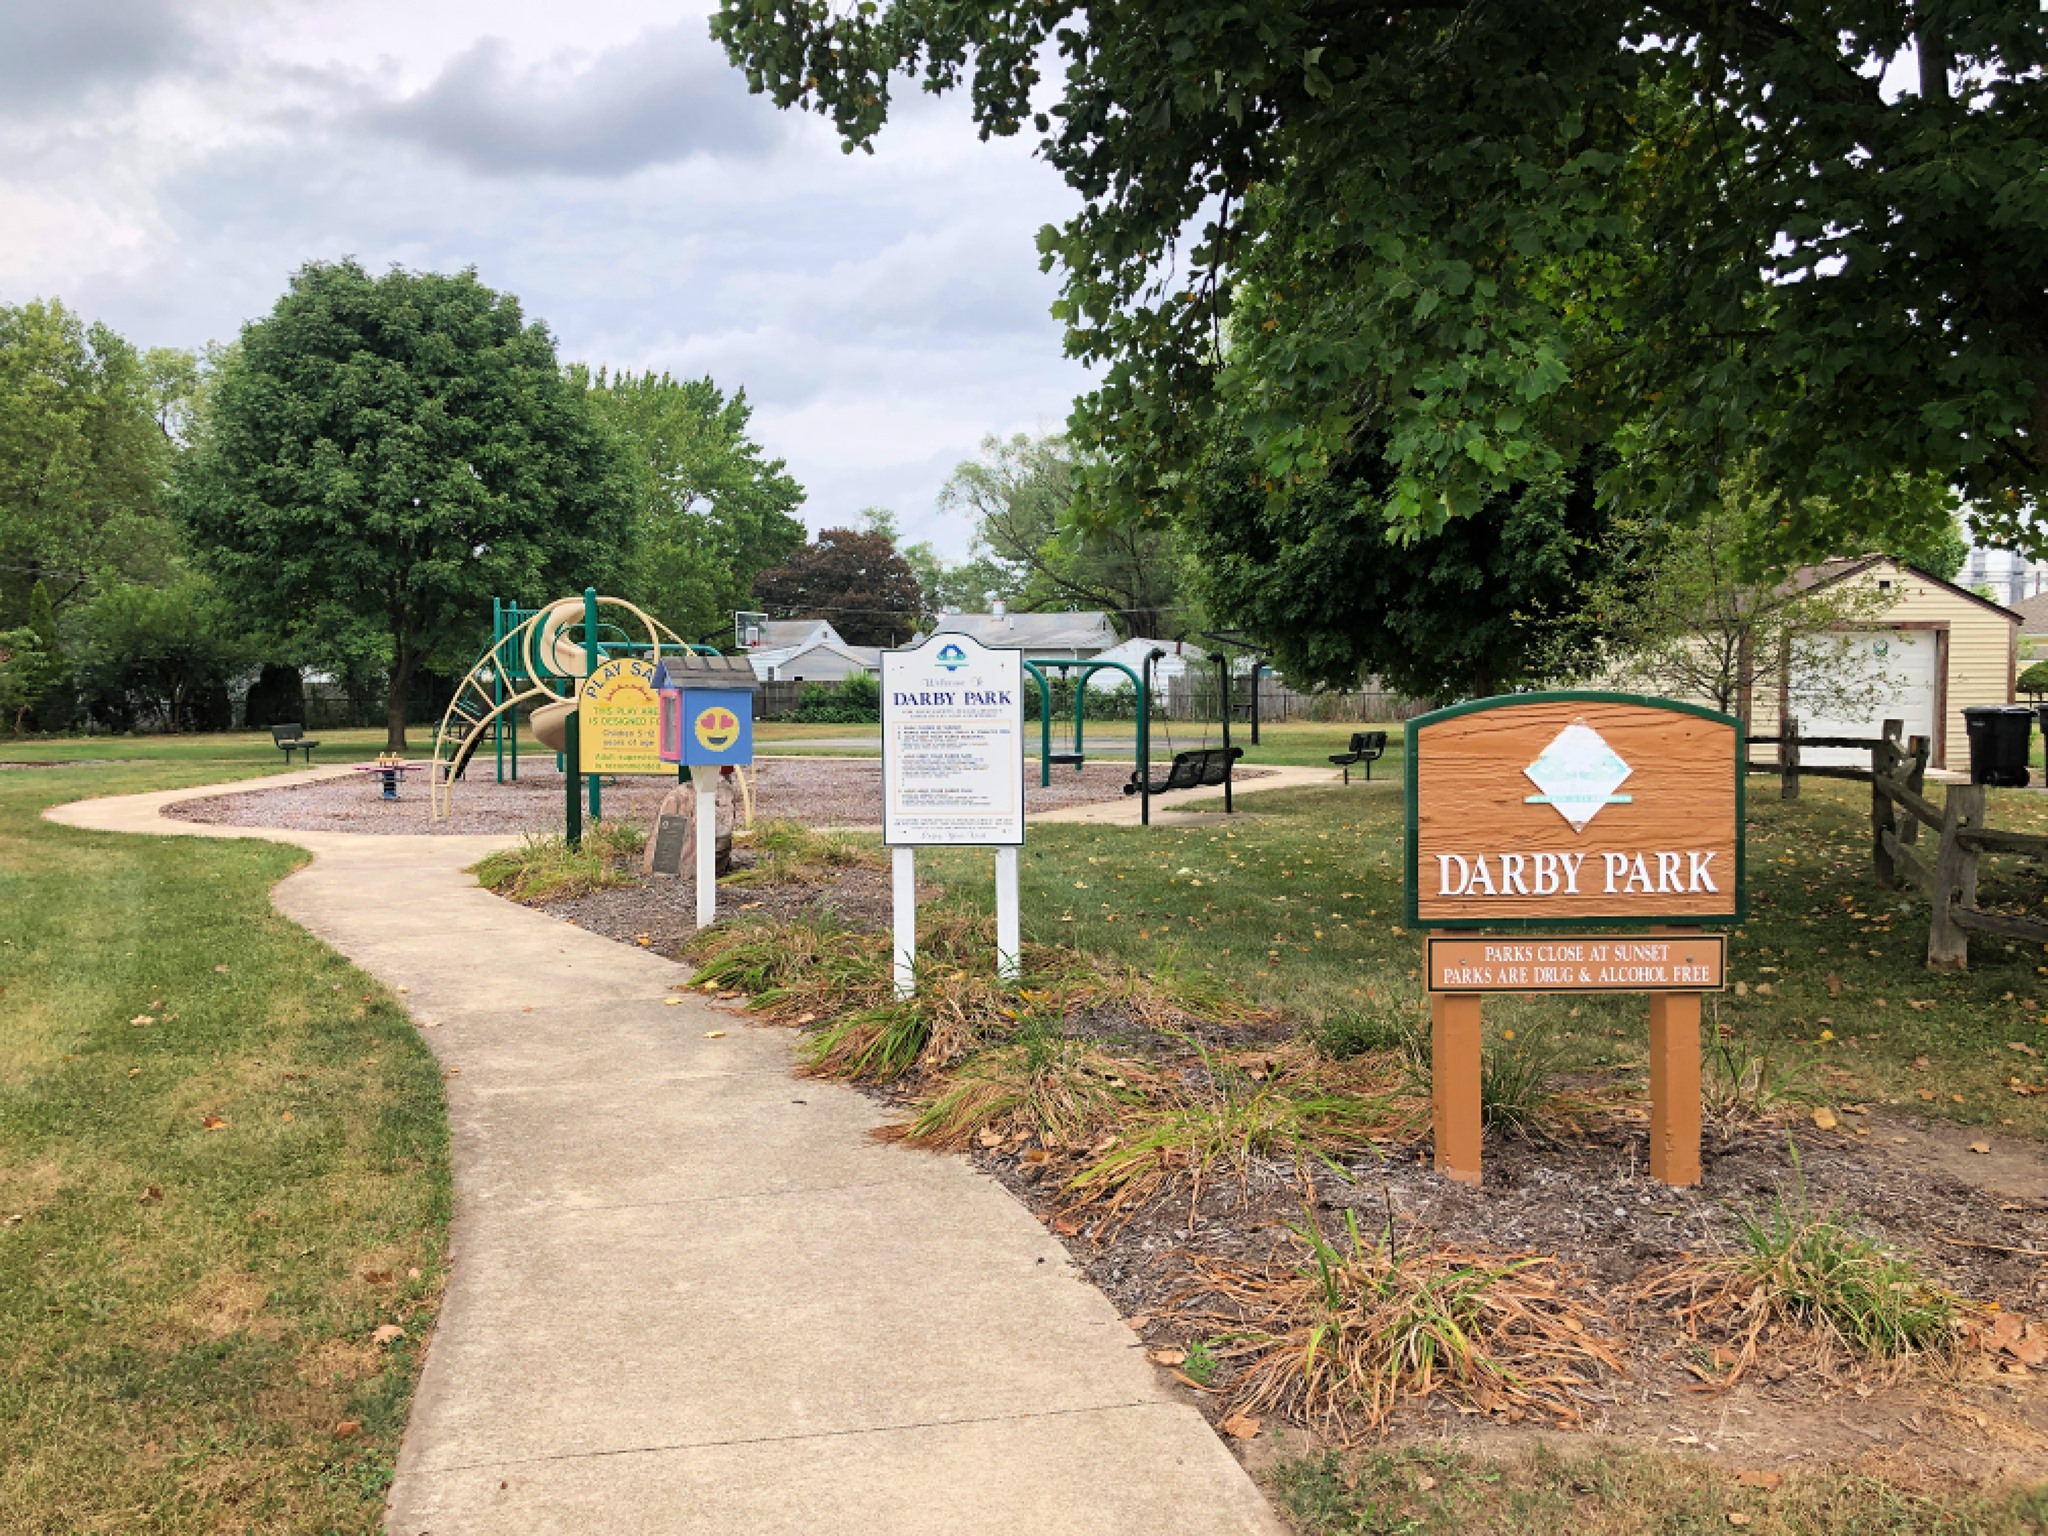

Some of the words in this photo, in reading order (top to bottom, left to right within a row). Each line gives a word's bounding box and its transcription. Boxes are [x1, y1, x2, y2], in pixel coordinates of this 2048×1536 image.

[587, 662, 620, 699] PLAY
[893, 691, 956, 706] DARBY
[964, 690, 1012, 706] PARK
[594, 707, 612, 715] THIS
[617, 707, 636, 715] PLAY
[642, 707, 660, 715] ARE
[588, 717, 598, 726] IS
[601, 717, 647, 726] DESIGNED
[604, 729, 634, 737] Children
[1436, 852, 1586, 896] DARBY
[1601, 851, 1720, 894] PARK
[1484, 945, 1533, 962] PARKS
[1538, 945, 1584, 961] CLOSE
[1589, 945, 1609, 961] AT
[1614, 944, 1670, 961] SUNSET
[1444, 967, 1492, 984] PARKS
[1497, 967, 1529, 984] ARE
[1534, 966, 1574, 983] DRUG
[1579, 966, 1592, 983] &
[1598, 966, 1669, 983] ALCOHOL
[1673, 965, 1711, 982] FREE
